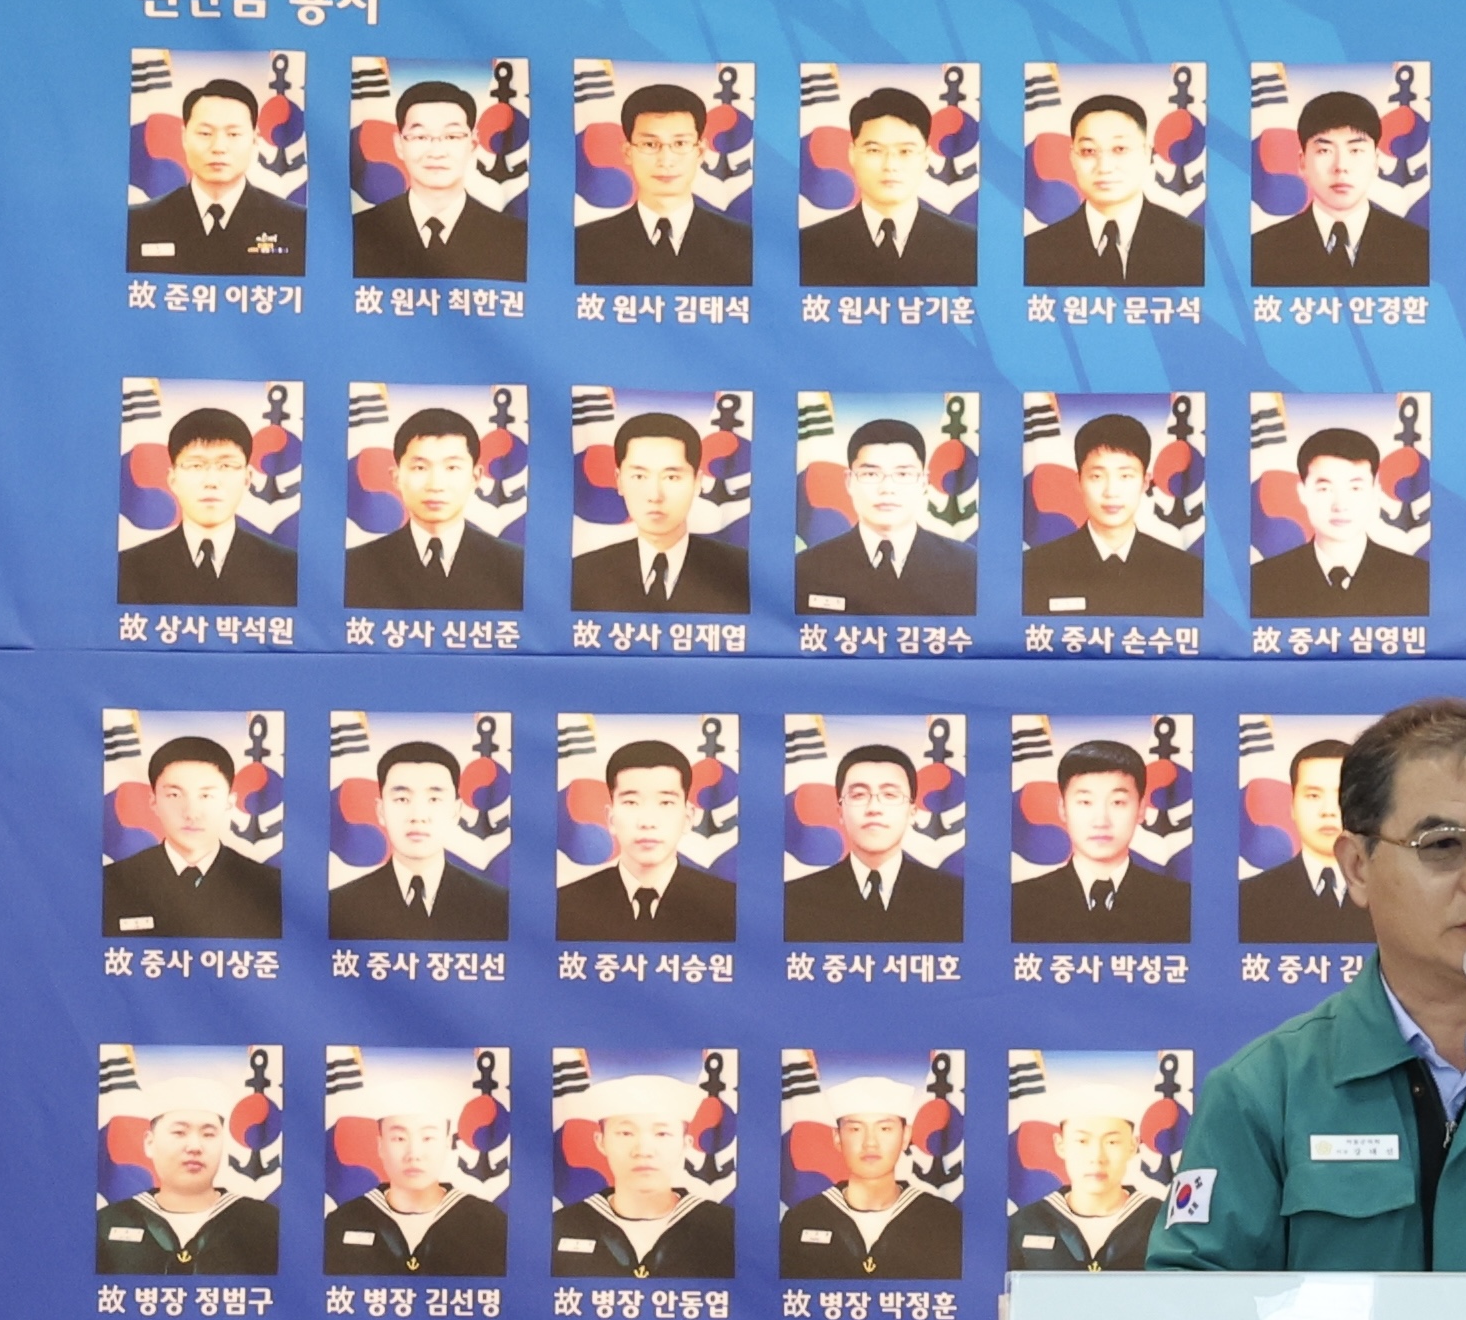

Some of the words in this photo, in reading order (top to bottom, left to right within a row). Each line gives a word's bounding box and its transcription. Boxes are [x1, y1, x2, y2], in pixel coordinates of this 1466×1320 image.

[128, 279, 157, 309] 故
[163, 283, 217, 313] 준위
[225, 284, 302, 315] 이창기
[576, 292, 606, 321] 故
[612, 295, 666, 324] 원사
[674, 295, 750, 324] 김태석
[801, 293, 831, 323] 故
[837, 296, 891, 325] 원사
[898, 296, 975, 325] 남기훈
[1027, 293, 1056, 323] 故
[1063, 296, 1117, 325] 원사
[1123, 296, 1201, 325] 문규석
[1253, 294, 1283, 323] 故
[1288, 296, 1343, 325] 상사
[1348, 295, 1430, 325] 안경환
[119, 612, 149, 642] 故
[154, 615, 209, 644] 상사
[216, 616, 294, 645] 박석원
[345, 616, 375, 646] 故
[381, 619, 436, 649] 상사
[441, 620, 521, 649] 신선준
[799, 623, 828, 652] 故
[834, 625, 888, 655] 상사
[896, 626, 973, 655] 김경수
[1025, 623, 1055, 652] 故
[1061, 626, 1115, 654] 중사
[1121, 626, 1199, 655] 손수민
[104, 946, 134, 976] 故
[140, 949, 194, 979] 중사
[200, 950, 280, 979] 이상준
[558, 950, 588, 980] 故
[594, 953, 649, 983] 중사
[655, 954, 733, 983] 서승원
[786, 951, 815, 981] 故
[822, 954, 876, 983] 중사
[882, 954, 961, 983] 서대호
[1013, 952, 1043, 982] 故
[1049, 955, 1104, 984] 중사
[1110, 955, 1189, 985] 박성균
[97, 1284, 127, 1314] 故
[135, 1287, 188, 1316] 병장
[194, 1287, 274, 1316] 정범구
[326, 1285, 356, 1315] 故
[363, 1288, 417, 1317] 병장
[425, 1288, 500, 1318] 김선명
[782, 1288, 812, 1318] 故
[819, 1291, 872, 1320] 병장
[879, 1291, 958, 1320] 박정훈
